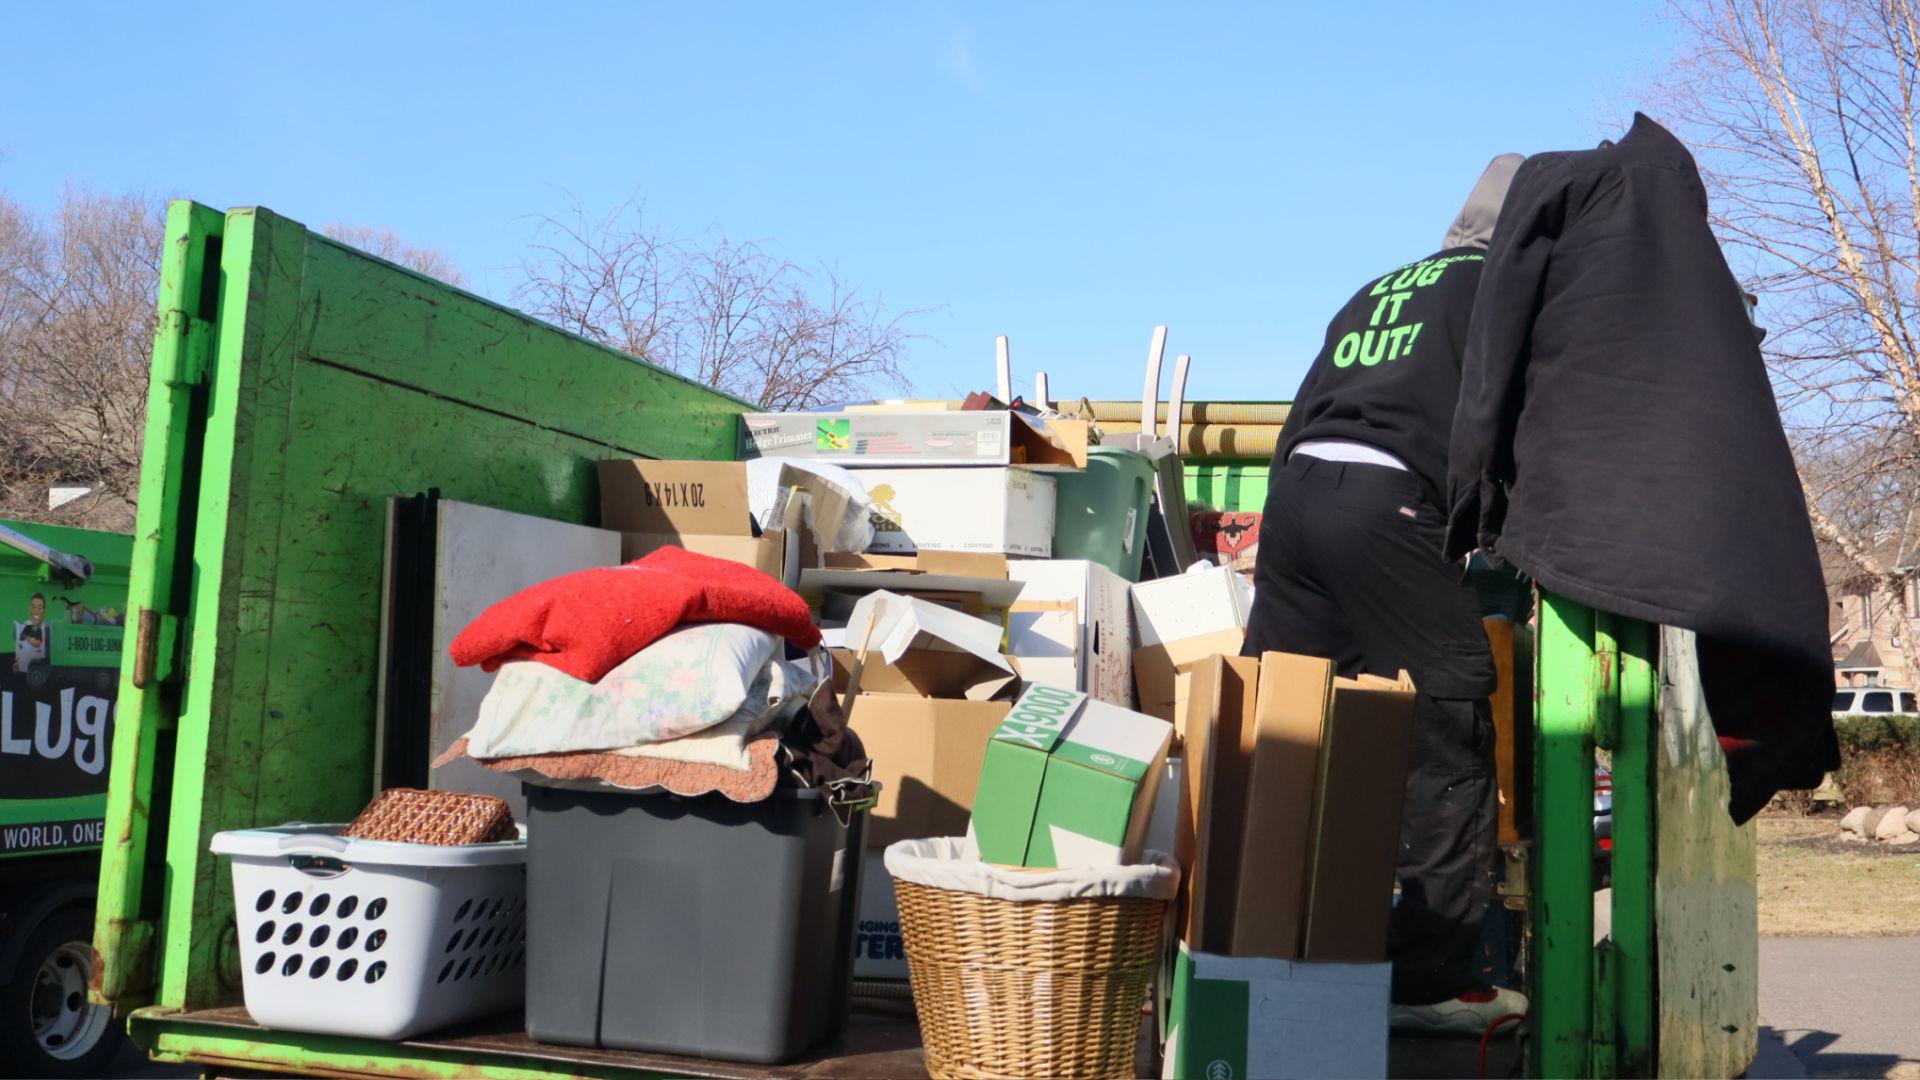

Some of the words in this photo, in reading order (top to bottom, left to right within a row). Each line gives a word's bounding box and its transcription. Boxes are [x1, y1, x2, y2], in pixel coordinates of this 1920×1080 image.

[1369, 262, 1449, 297] LUG
[1369, 290, 1413, 326] IT
[1333, 321, 1424, 369] OUT!
[995, 686, 1078, 748] X-9000
[4, 825, 68, 849] WORLD,
[72, 821, 104, 844] ONE
